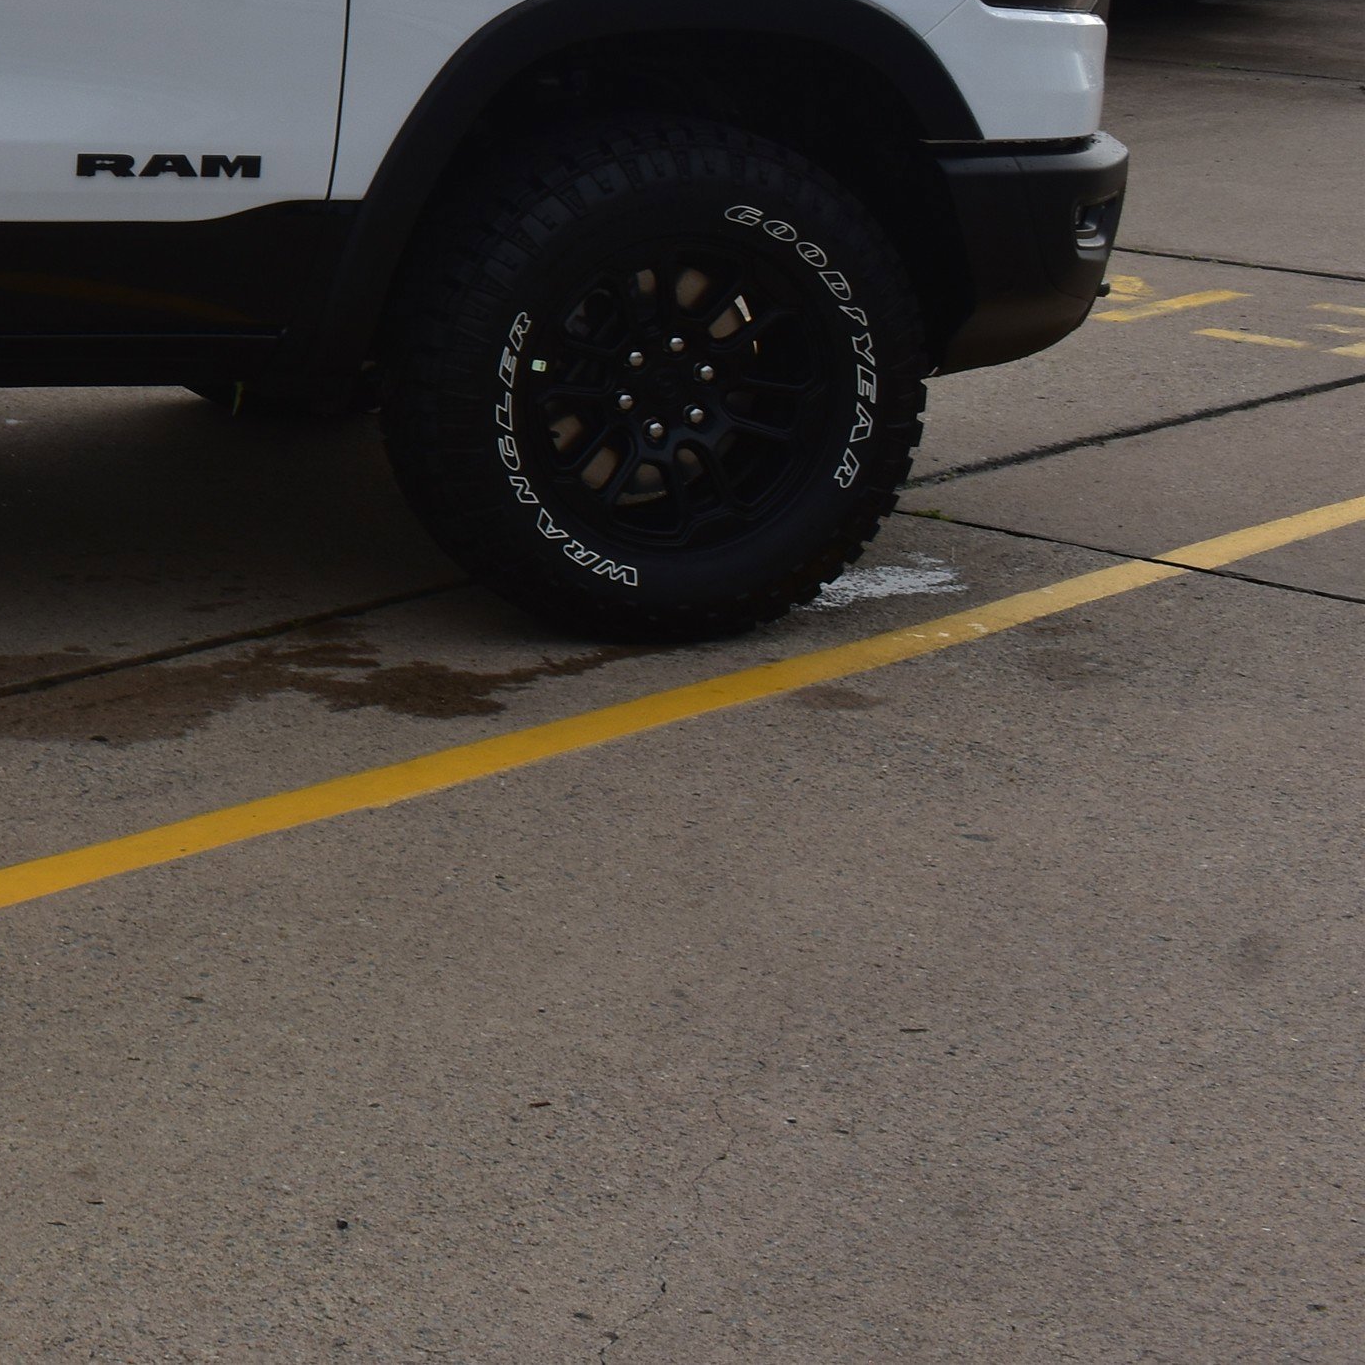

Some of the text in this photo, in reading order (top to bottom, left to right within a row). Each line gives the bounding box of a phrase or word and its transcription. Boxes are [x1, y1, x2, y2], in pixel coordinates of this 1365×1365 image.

[76, 153, 262, 178] RAM
[495, 311, 639, 587] WRANGLER
[724, 205, 877, 488] GOODYEAR
